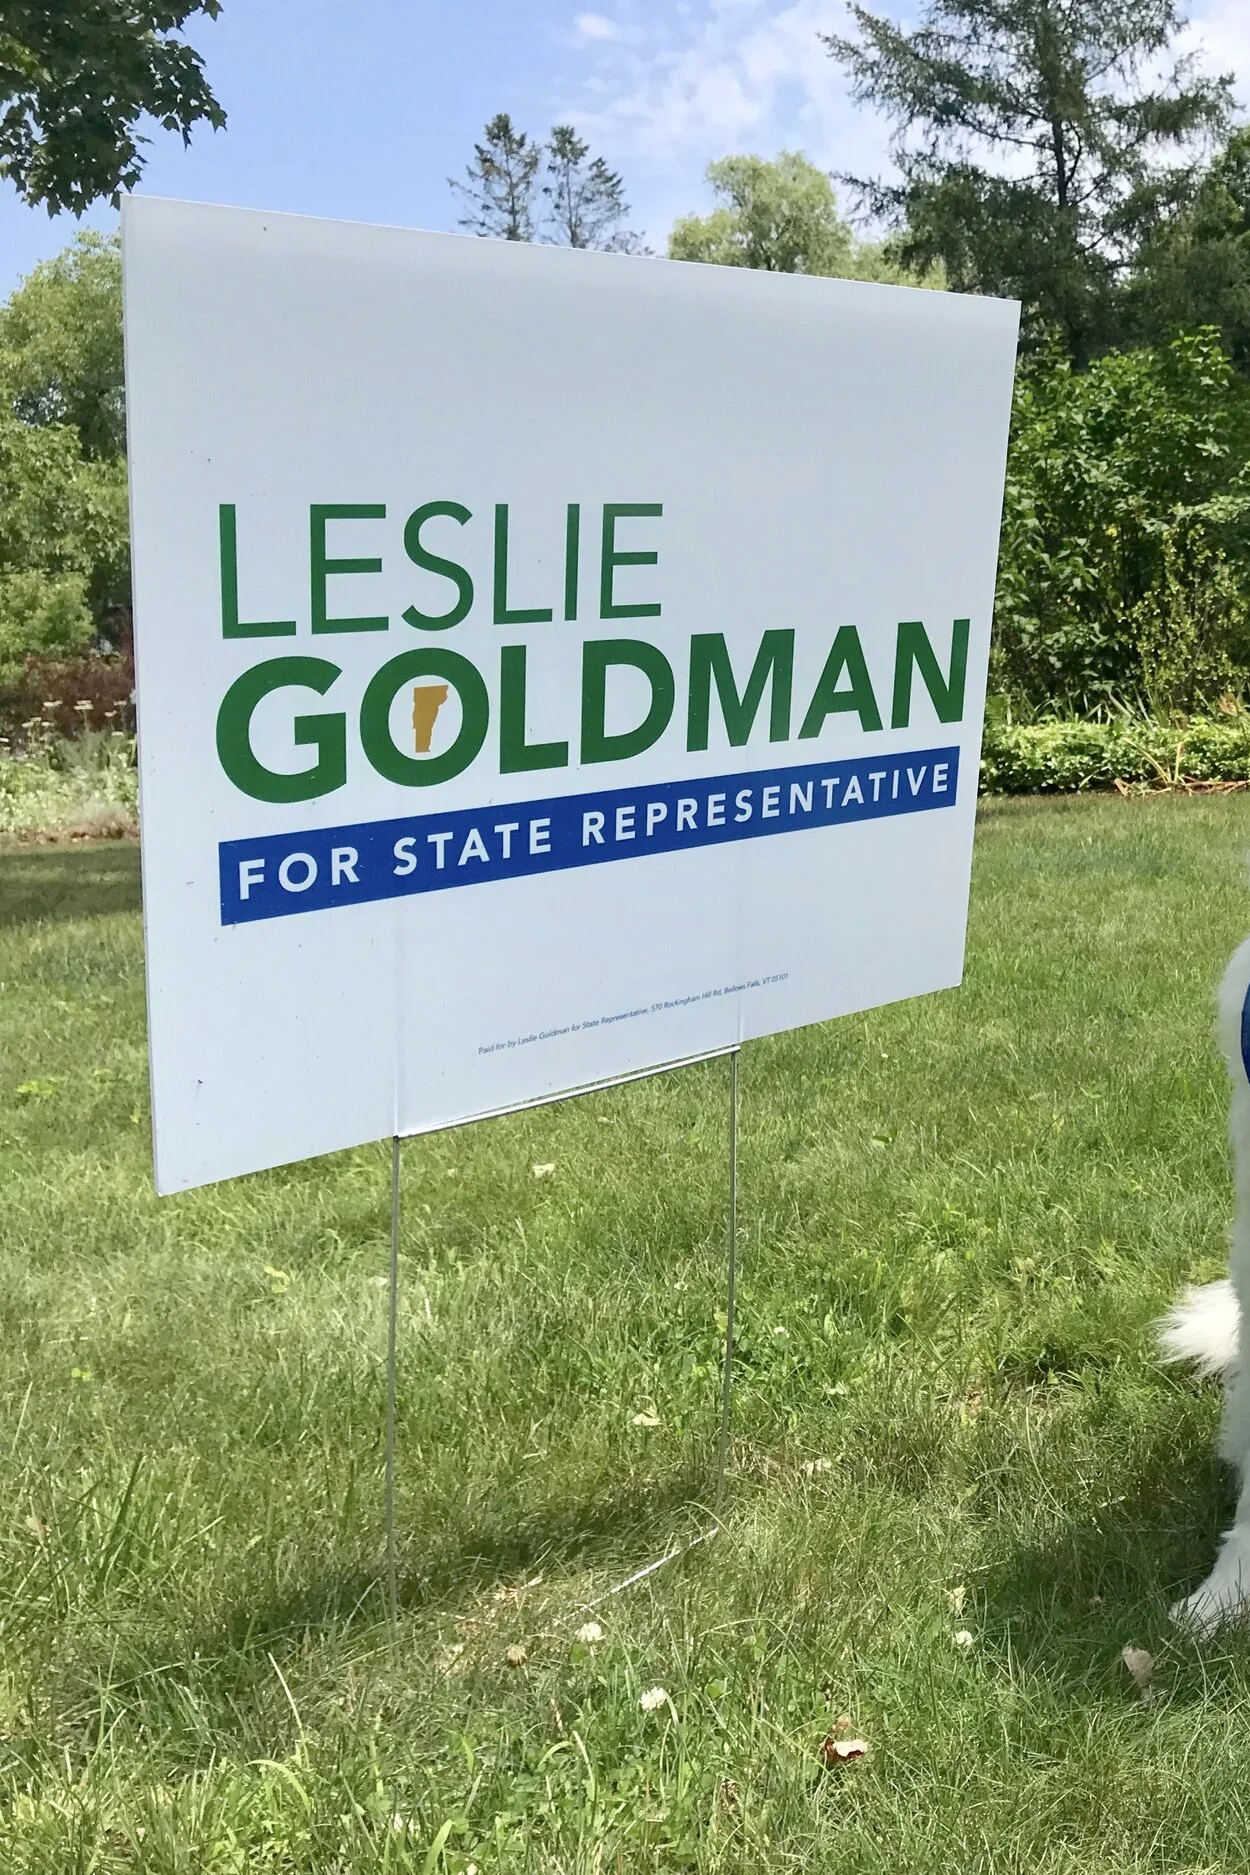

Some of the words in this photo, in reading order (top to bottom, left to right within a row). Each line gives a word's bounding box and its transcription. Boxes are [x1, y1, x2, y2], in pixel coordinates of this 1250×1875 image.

[218, 500, 663, 640] LESLIE
[216, 619, 971, 804] GOLDMAN
[237, 847, 360, 901] FOR
[392, 817, 552, 877] STATE
[581, 763, 951, 847] REPRESENTATIVE
[478, 1045, 495, 1055] Paid
[495, 1042, 506, 1051] for
[507, 1039, 517, 1048] by
[517, 1034, 537, 1046] Leslie
[538, 1027, 570, 1040] Goldman
[571, 1023, 581, 1032] for
[582, 1019, 600, 1030] State
[600, 1007, 649, 1025] Representative,
[650, 1003, 663, 1013] 570
[663, 995, 701, 1009] Rockingham
[701, 990, 712, 999] Hill
[712, 988, 723, 998] Rd,
[723, 984, 746, 995] Bellows
[762, 976, 771, 985] VT
[770, 972, 789, 983] 05101
